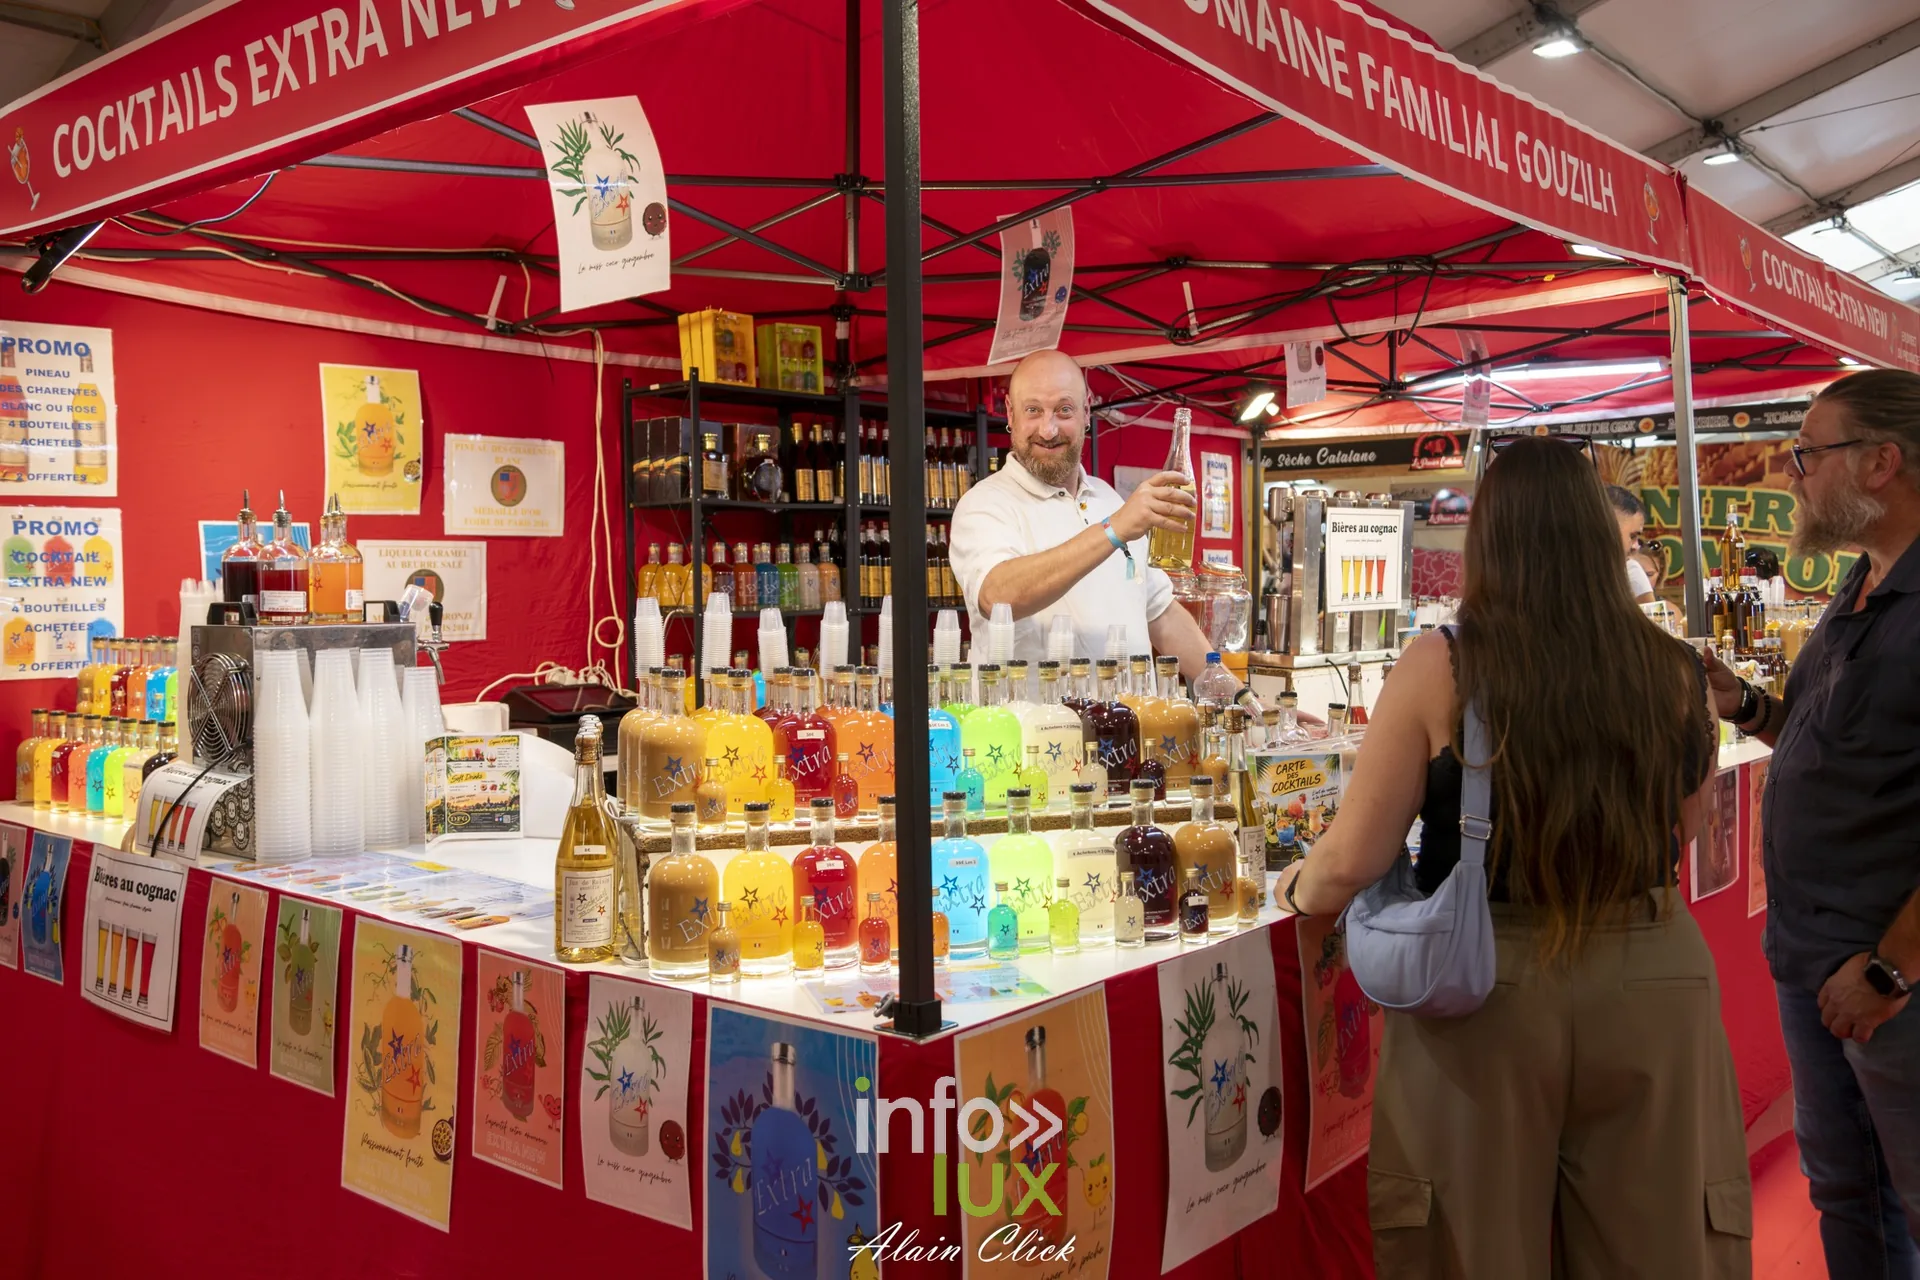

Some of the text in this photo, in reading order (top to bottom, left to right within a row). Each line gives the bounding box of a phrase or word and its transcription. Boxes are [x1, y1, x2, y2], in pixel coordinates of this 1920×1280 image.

[53, 55, 238, 178] COCKTAILS
[245, 0, 388, 106] EXTRA
[1357, 52, 1508, 174] FAMILIAL
[1515, 131, 1617, 216] GOUZILH
[1762, 250, 1834, 316] COCKTAILS
[1864, 303, 1887, 340] NEW
[1, 337, 91, 357] PROMO
[25, 368, 71, 378] PINEAU
[0, 384, 98, 397] DES CHARENTES
[1, 402, 42, 412] BLANC
[45, 404, 63, 413] OU
[8, 420, 92, 431] 4 BOUTEILLES
[1276, 454, 1312, 468] Sèche
[1316, 447, 1377, 466] Catalane
[1206, 460, 1228, 470] PROMO
[16, 473, 88, 482] 2 OFFERTES
[13, 520, 99, 536] PROMO
[1331, 521, 1398, 535] Bières au cognac
[14, 551, 101, 564] COCKTAIL
[378, 548, 468, 558] LIQUEUR CARAMEL
[385, 560, 397, 569] AU
[8, 576, 107, 588] EXTRA NEW
[11, 603, 106, 613] 4 BOUTEILLES
[443, 611, 473, 620] RONZE
[424, 624, 452, 633] PIS
[18, 664, 26, 672] 2
[1099, 736, 1137, 771] xtra
[1275, 760, 1306, 775] CARTE
[1286, 772, 1299, 780] DES
[1271, 774, 1321, 794] COCKTAILS
[94, 866, 177, 902] Bières au cognac
[1139, 865, 1176, 904] xtra
[504, 1039, 535, 1076] Extra
[754, 1157, 814, 1216] Extra
